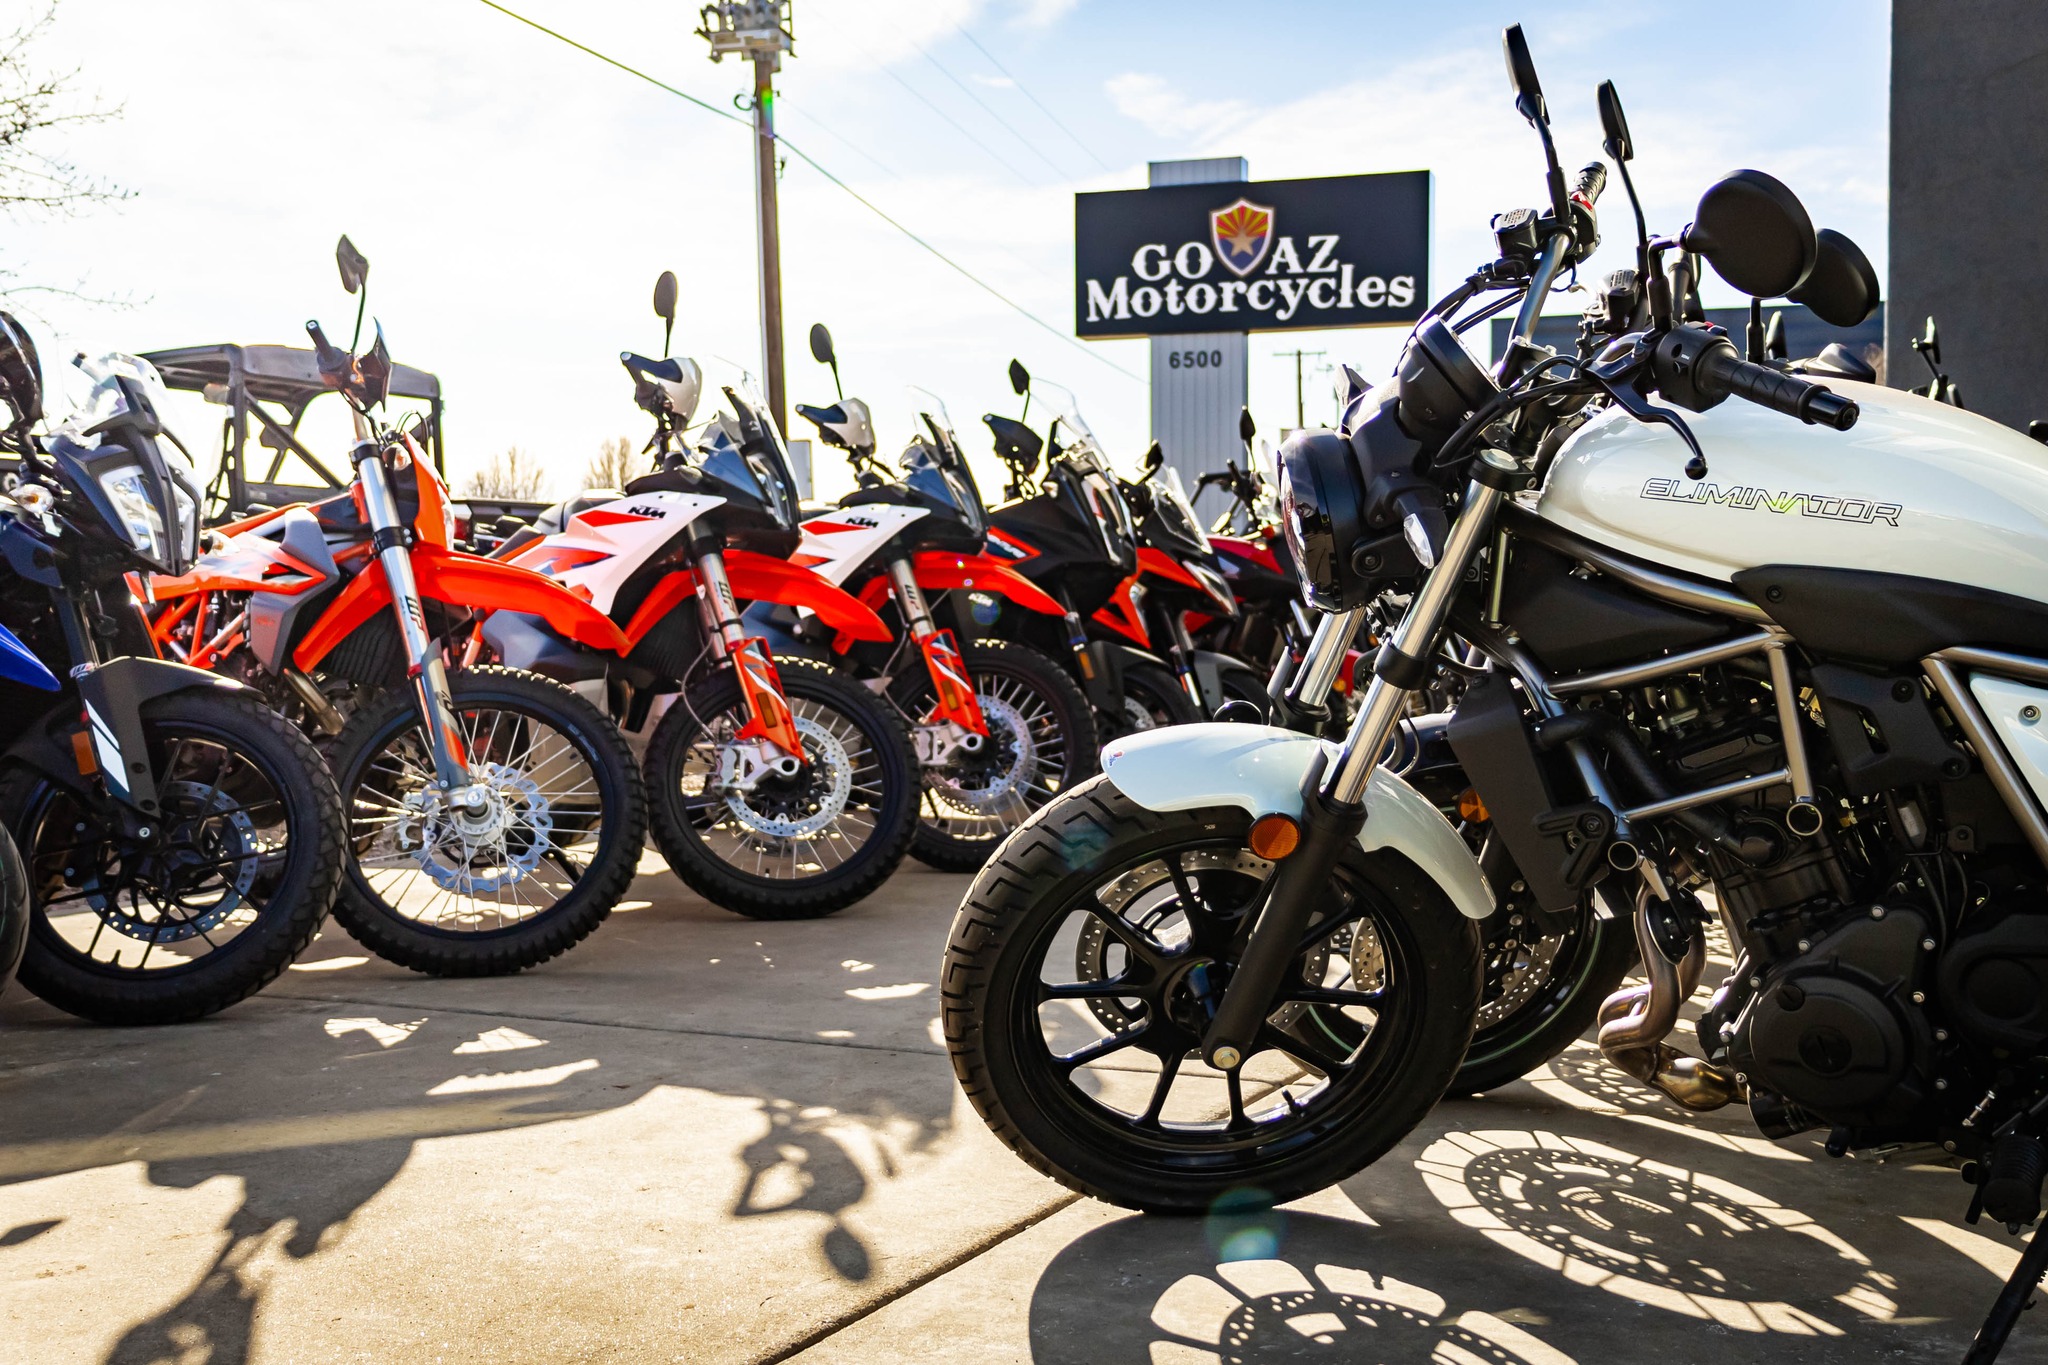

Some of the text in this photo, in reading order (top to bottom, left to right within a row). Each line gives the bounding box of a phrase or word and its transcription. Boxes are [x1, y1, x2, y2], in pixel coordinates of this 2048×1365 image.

[1131, 235, 1341, 281] GO AZ
[1086, 264, 1415, 321] Motorcycles
[1169, 350, 1222, 369] 6500
[627, 505, 666, 519] KTM
[1640, 478, 1903, 527] ELIMINATOR
[845, 517, 879, 528] KTM
